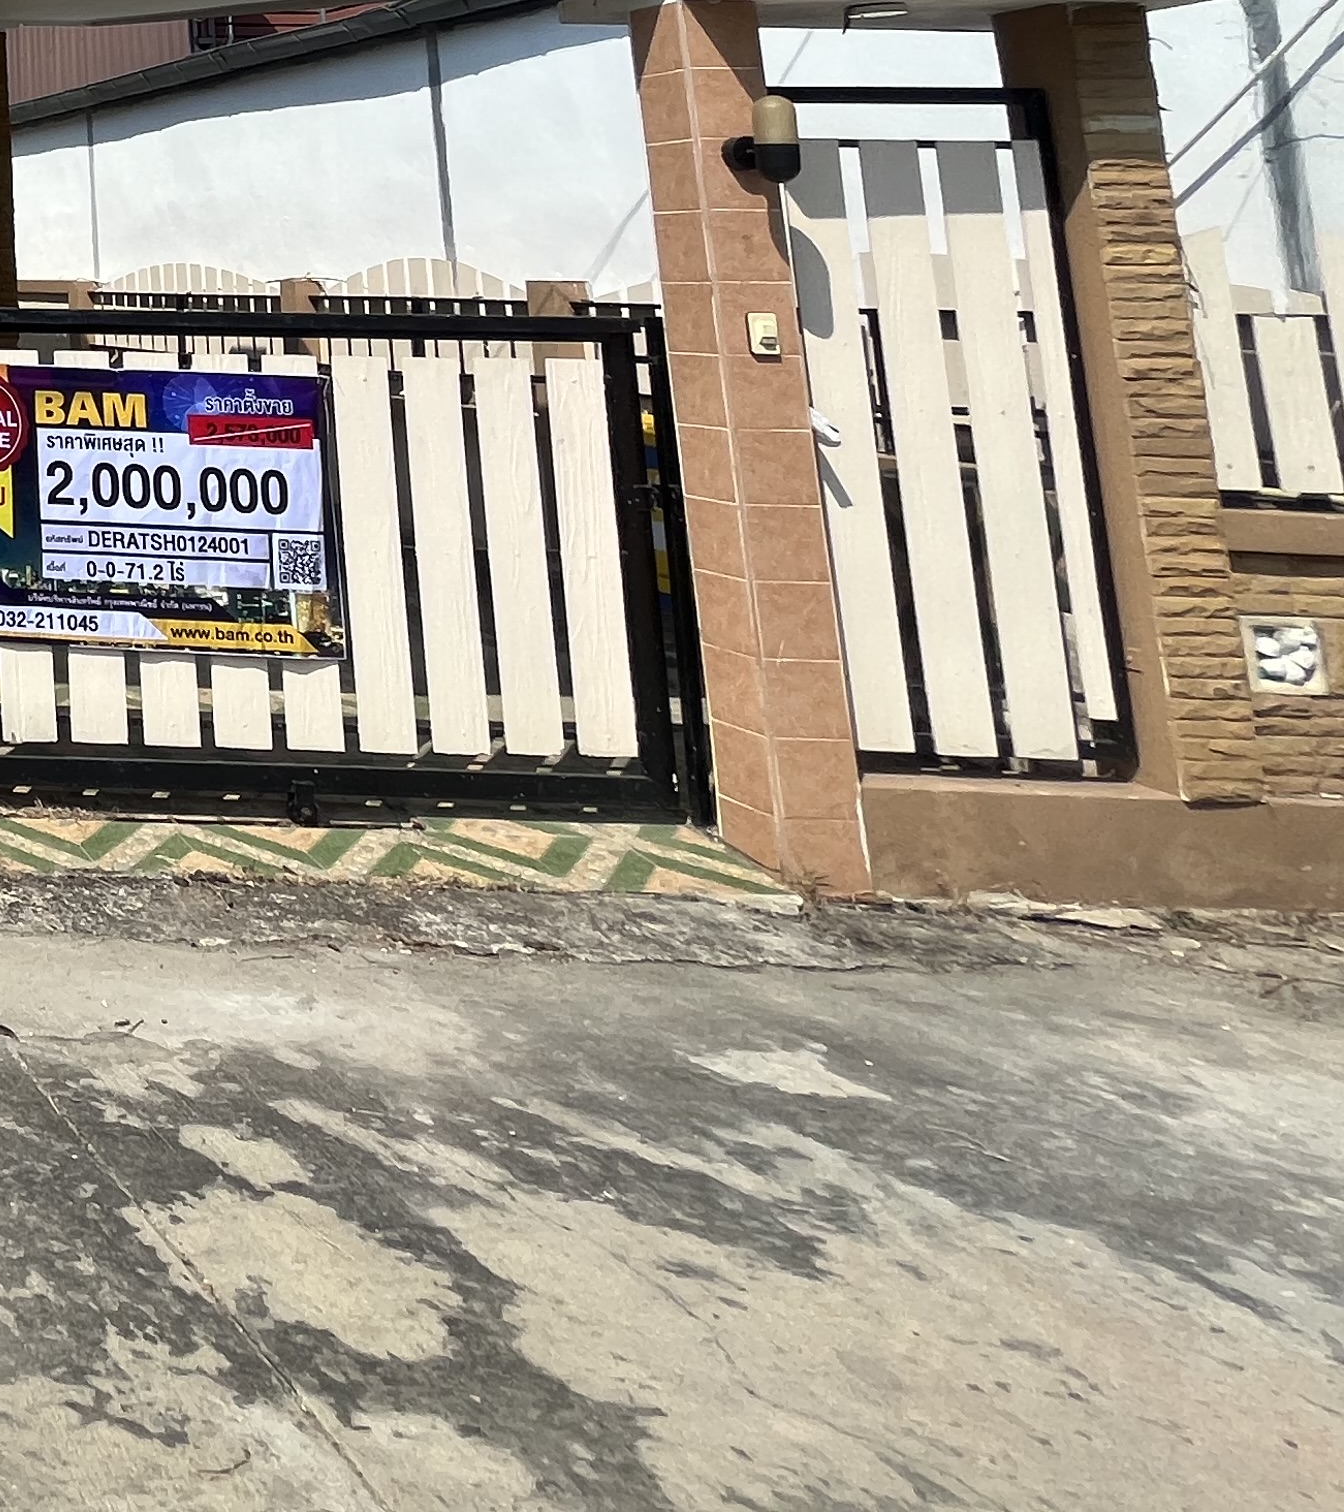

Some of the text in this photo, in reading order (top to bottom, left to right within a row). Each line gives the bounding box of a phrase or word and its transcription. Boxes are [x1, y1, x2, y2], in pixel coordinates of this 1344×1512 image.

[34, 390, 147, 428] BAM
[205, 388, 294, 416] ราคาตั้งขาย
[46, 433, 146, 458] ราคาพิเศษสุด
[46, 461, 288, 520] 2,000,000
[88, 530, 249, 554] DERATSH0124001
[86, 560, 163, 581] 0-0-71.2
[167, 561, 185, 581] ไร่
[170, 626, 294, 644] www.bam.co.th
